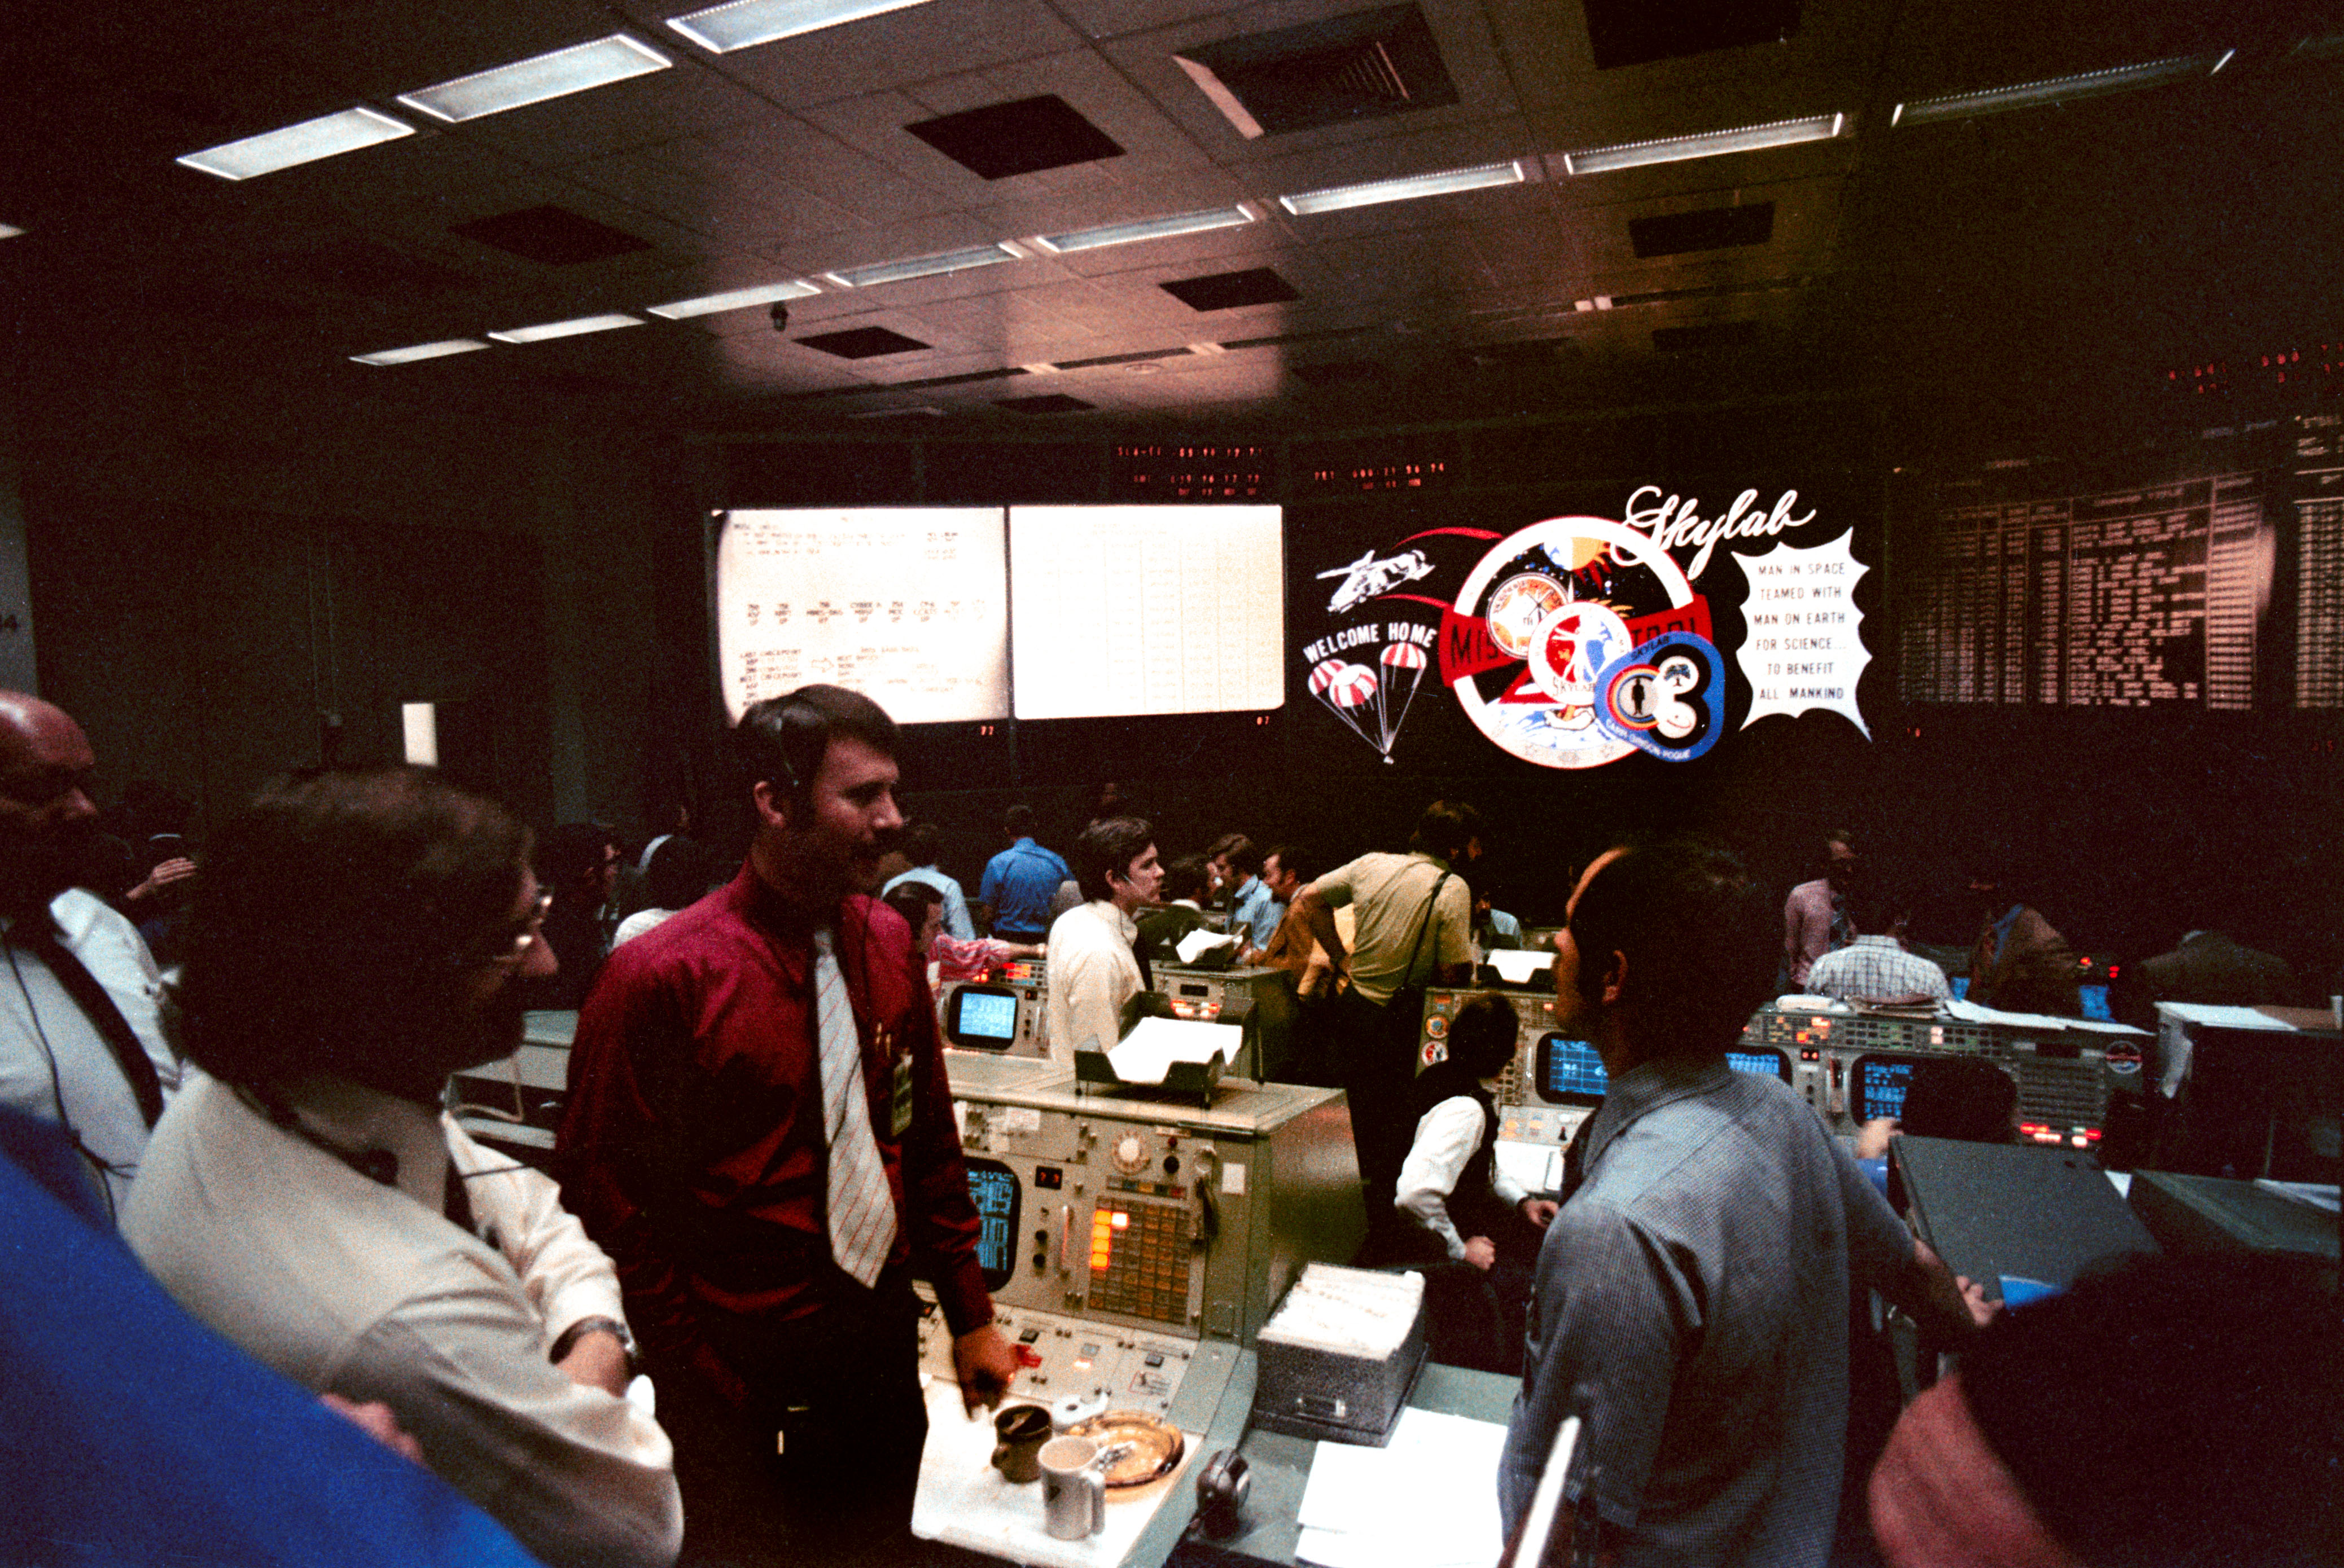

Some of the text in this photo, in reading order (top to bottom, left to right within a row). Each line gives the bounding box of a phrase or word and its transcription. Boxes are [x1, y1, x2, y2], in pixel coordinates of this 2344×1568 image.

[1610, 485, 1816, 580] Skylab
[1758, 562, 1845, 576] MAN IN SPACE
[1760, 586, 1842, 601] TEAMED WITH
[1753, 611, 1846, 626] MAN ON EARTH
[1303, 621, 1438, 664] WELCOME HOME
[1755, 638, 1777, 651] FOR
[1767, 661, 1835, 675] TO BENEFIT
[1759, 686, 1844, 700] ALL MANKIND
